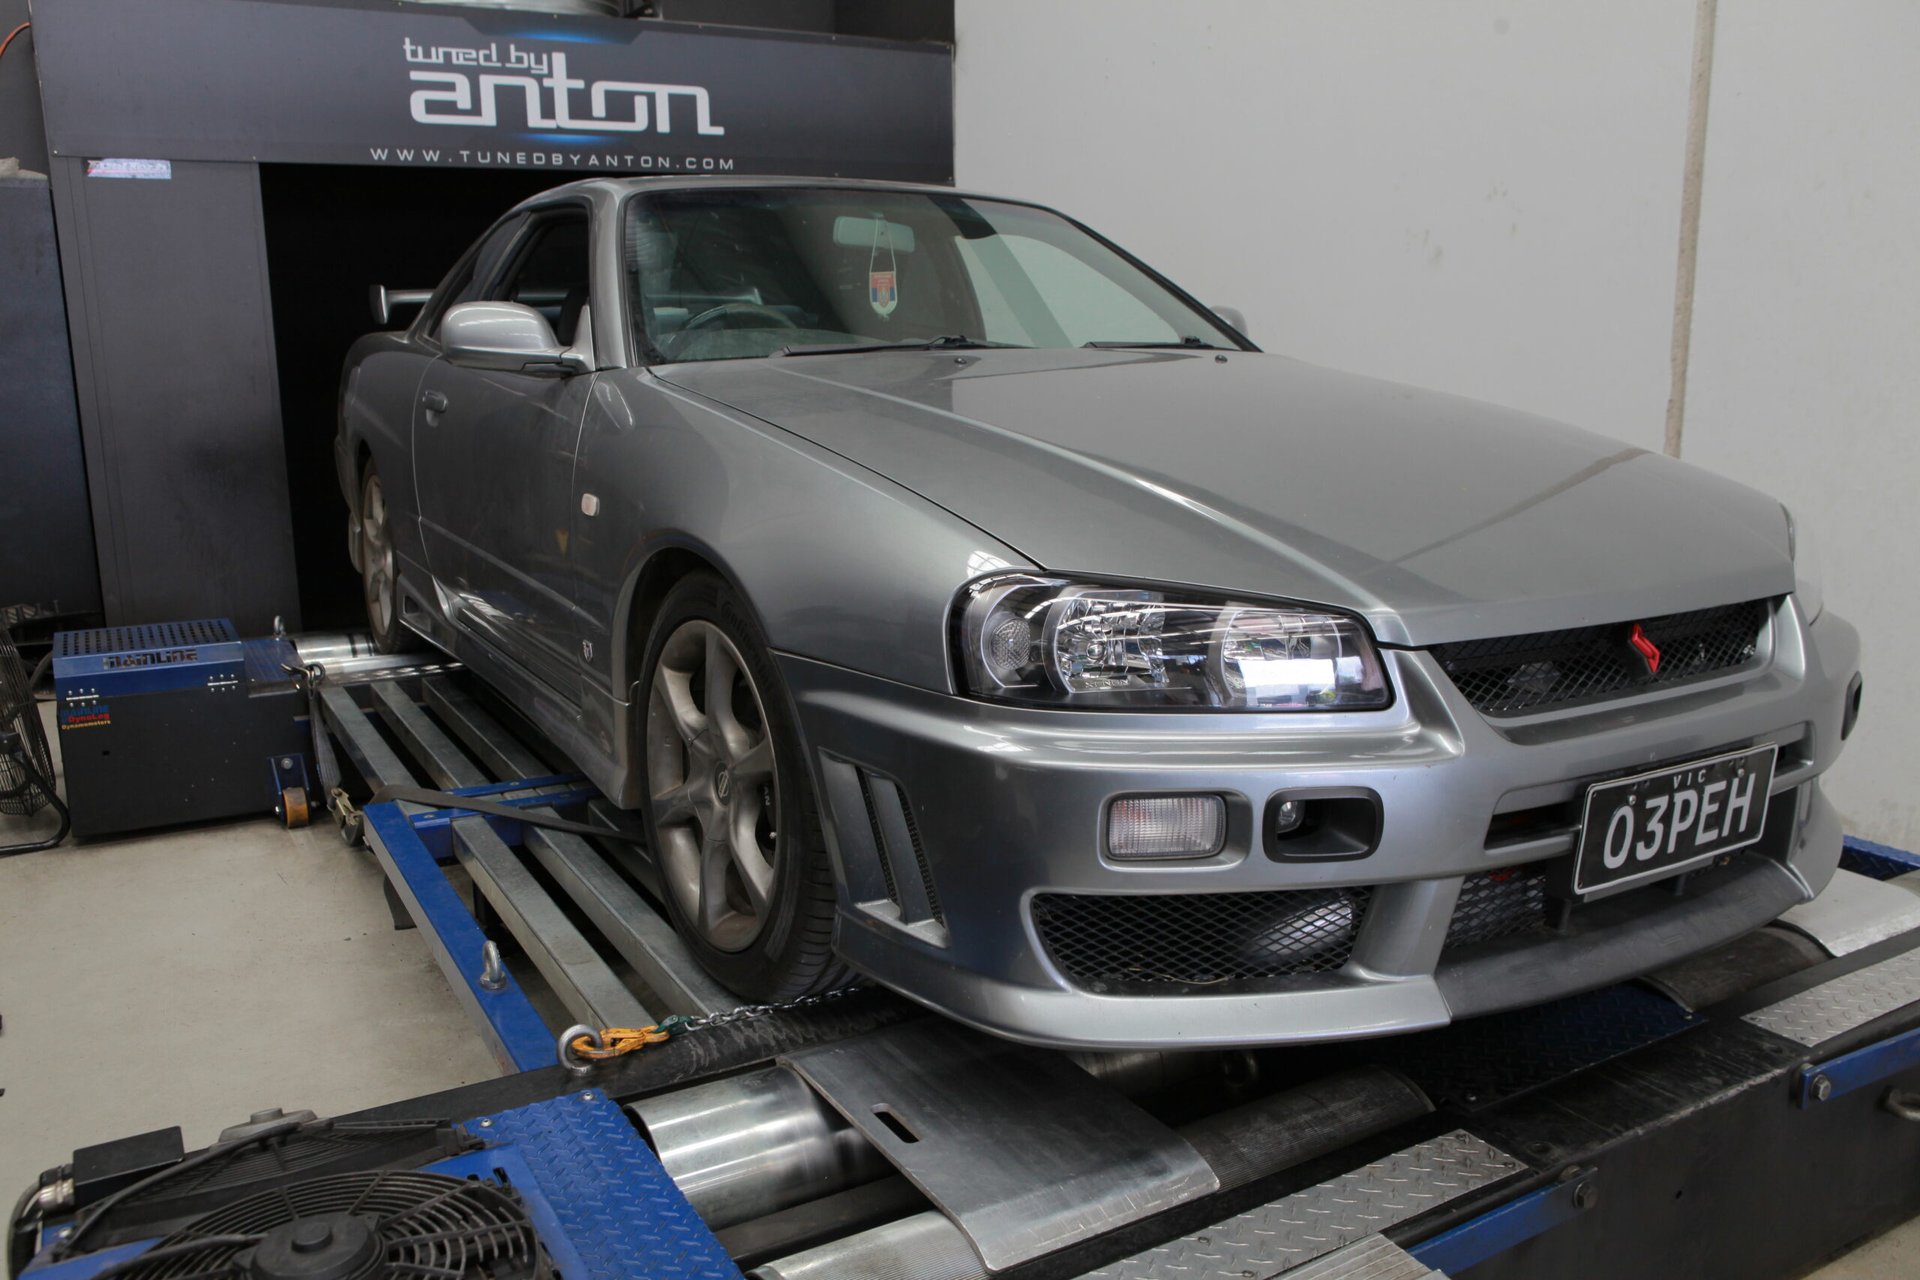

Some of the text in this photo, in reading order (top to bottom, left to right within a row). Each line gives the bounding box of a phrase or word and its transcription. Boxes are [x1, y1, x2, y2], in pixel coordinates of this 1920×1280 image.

[402, 37, 549, 75] tuned by
[409, 51, 726, 136] anton
[369, 147, 735, 171] WWW.TUNEDBYANTON.COM
[1673, 768, 1707, 790] VIC
